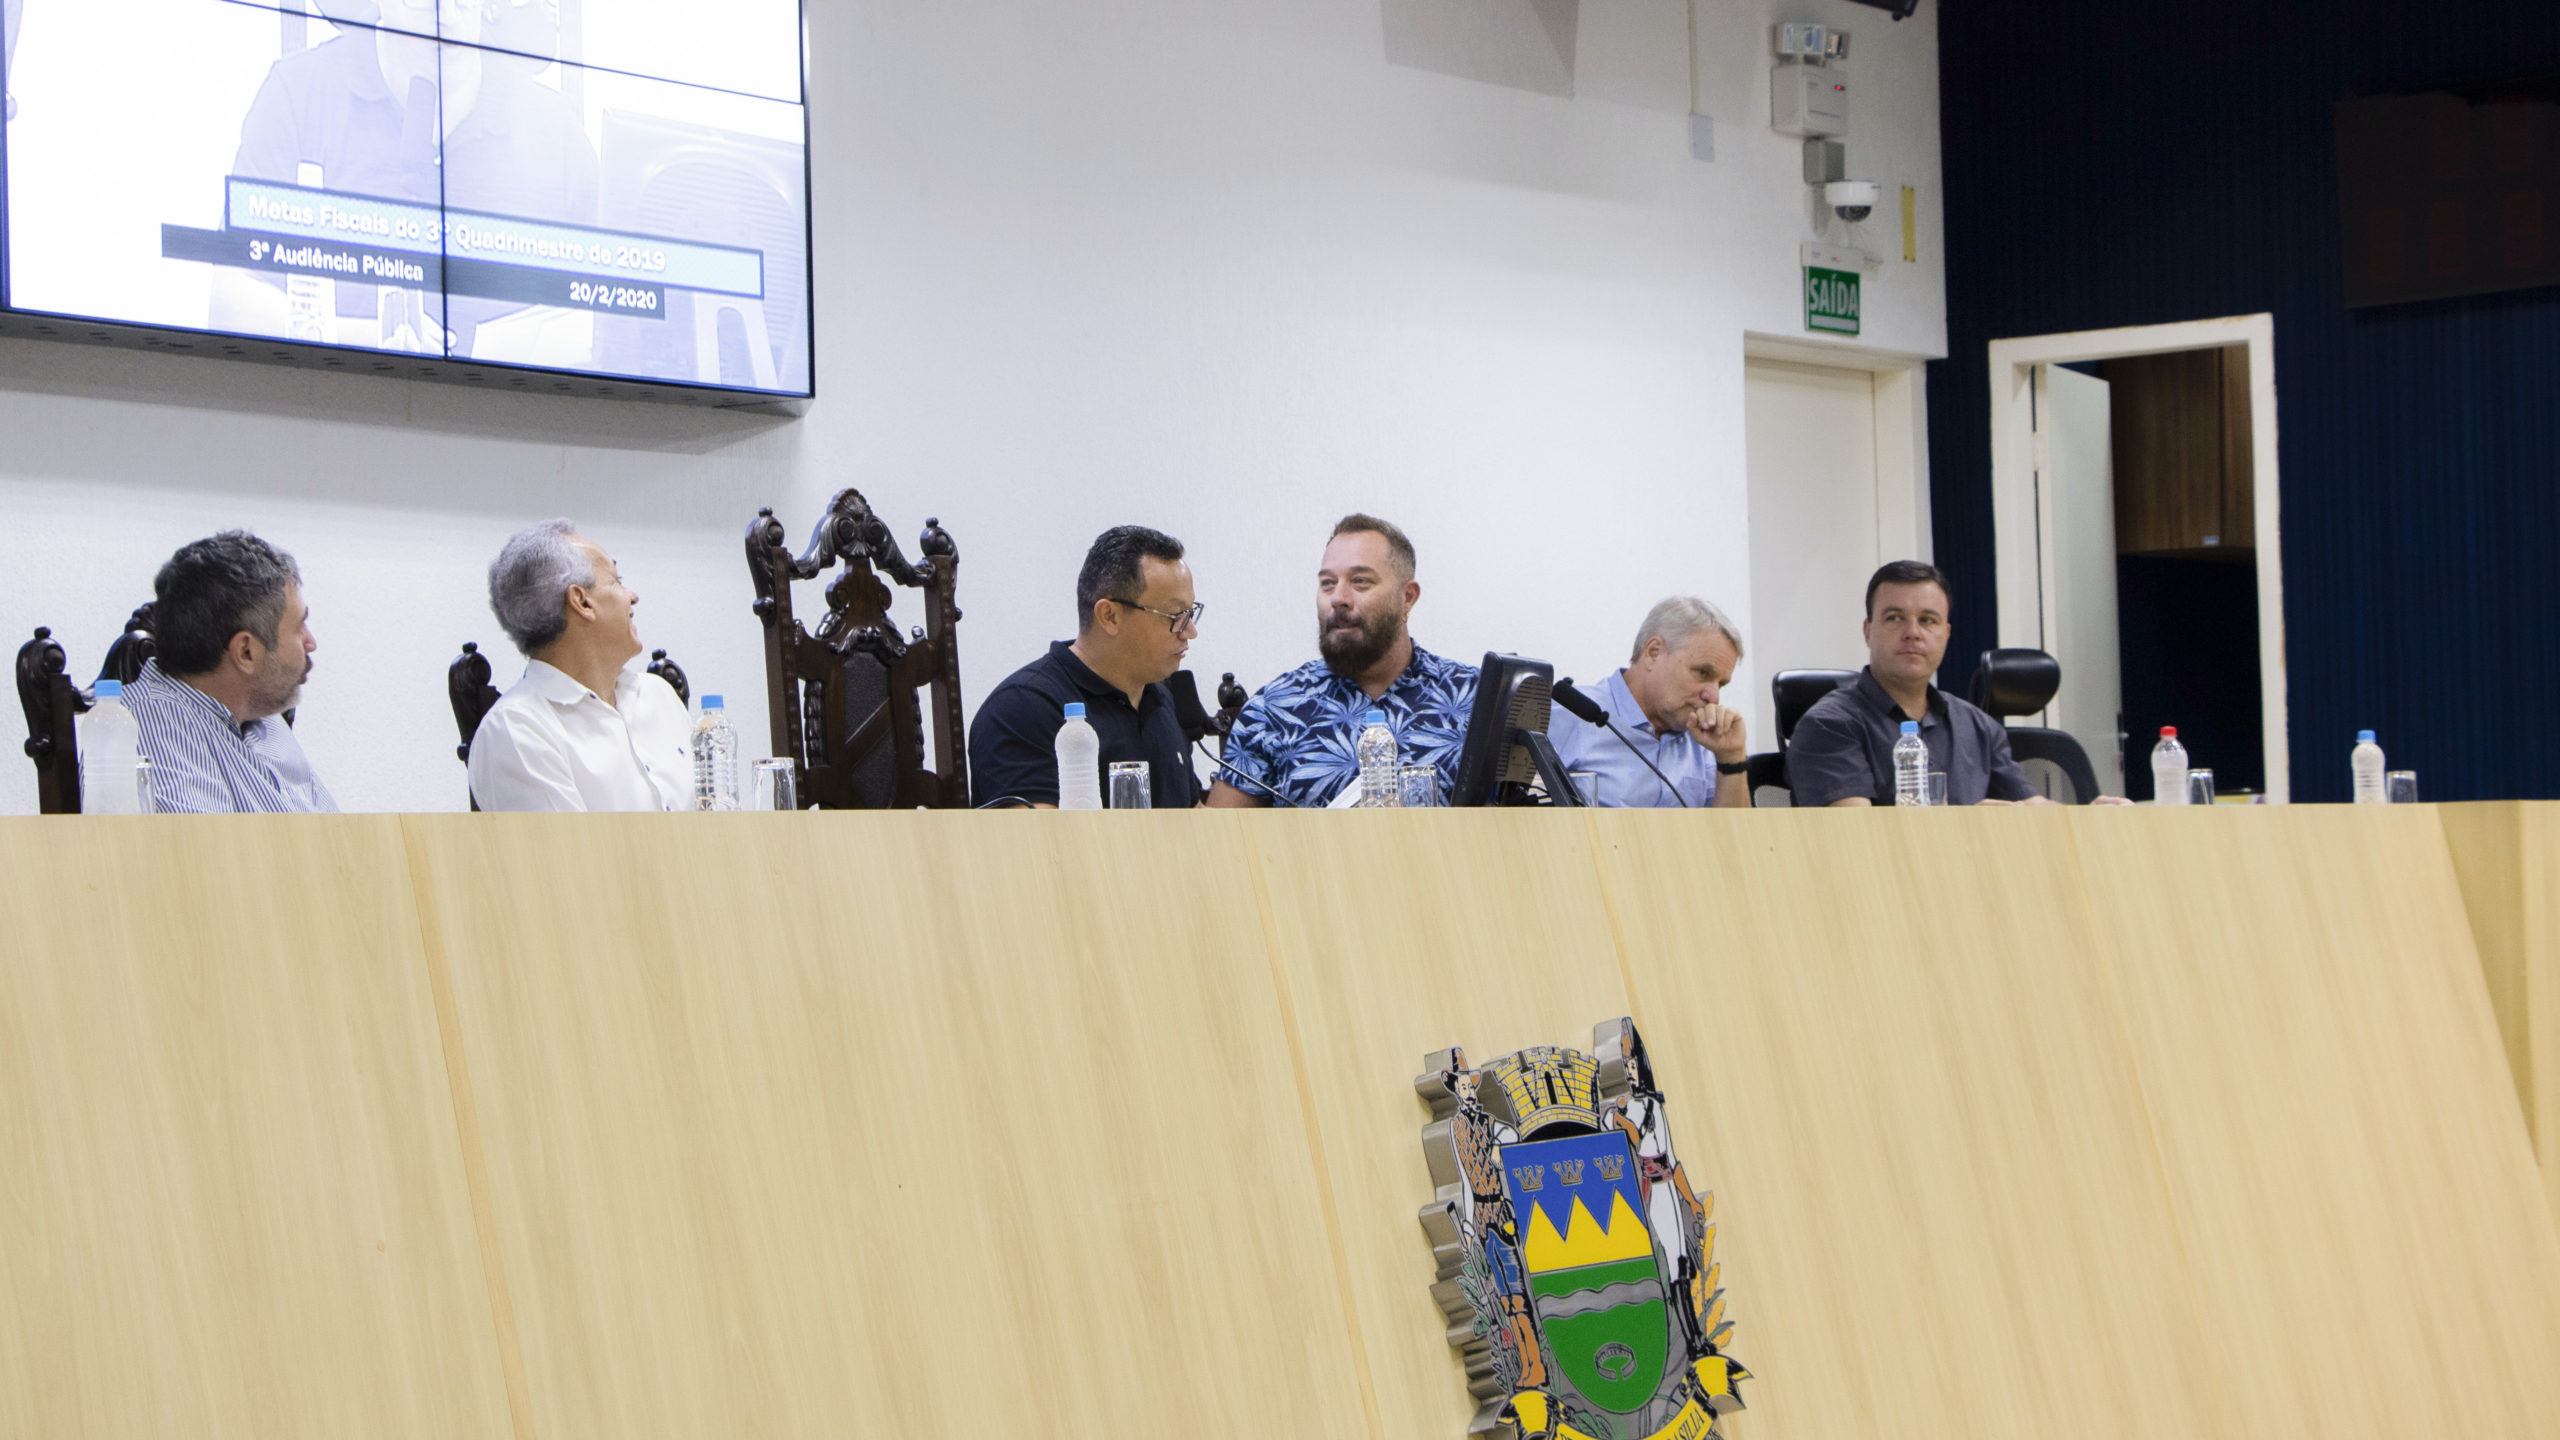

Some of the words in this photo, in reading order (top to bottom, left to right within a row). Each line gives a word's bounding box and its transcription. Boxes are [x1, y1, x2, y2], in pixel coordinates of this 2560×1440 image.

[249, 195, 314, 225] Metas
[320, 206, 390, 235] Fiscais
[394, 215, 421, 240] do
[455, 223, 584, 261] Quadrimestre
[588, 243, 613, 265] de
[616, 246, 666, 273] 2019
[273, 243, 358, 274] Audiência
[362, 252, 424, 282] Pública
[569, 281, 657, 310] 20/2/2020
[1809, 273, 1859, 317] SAÍDA
